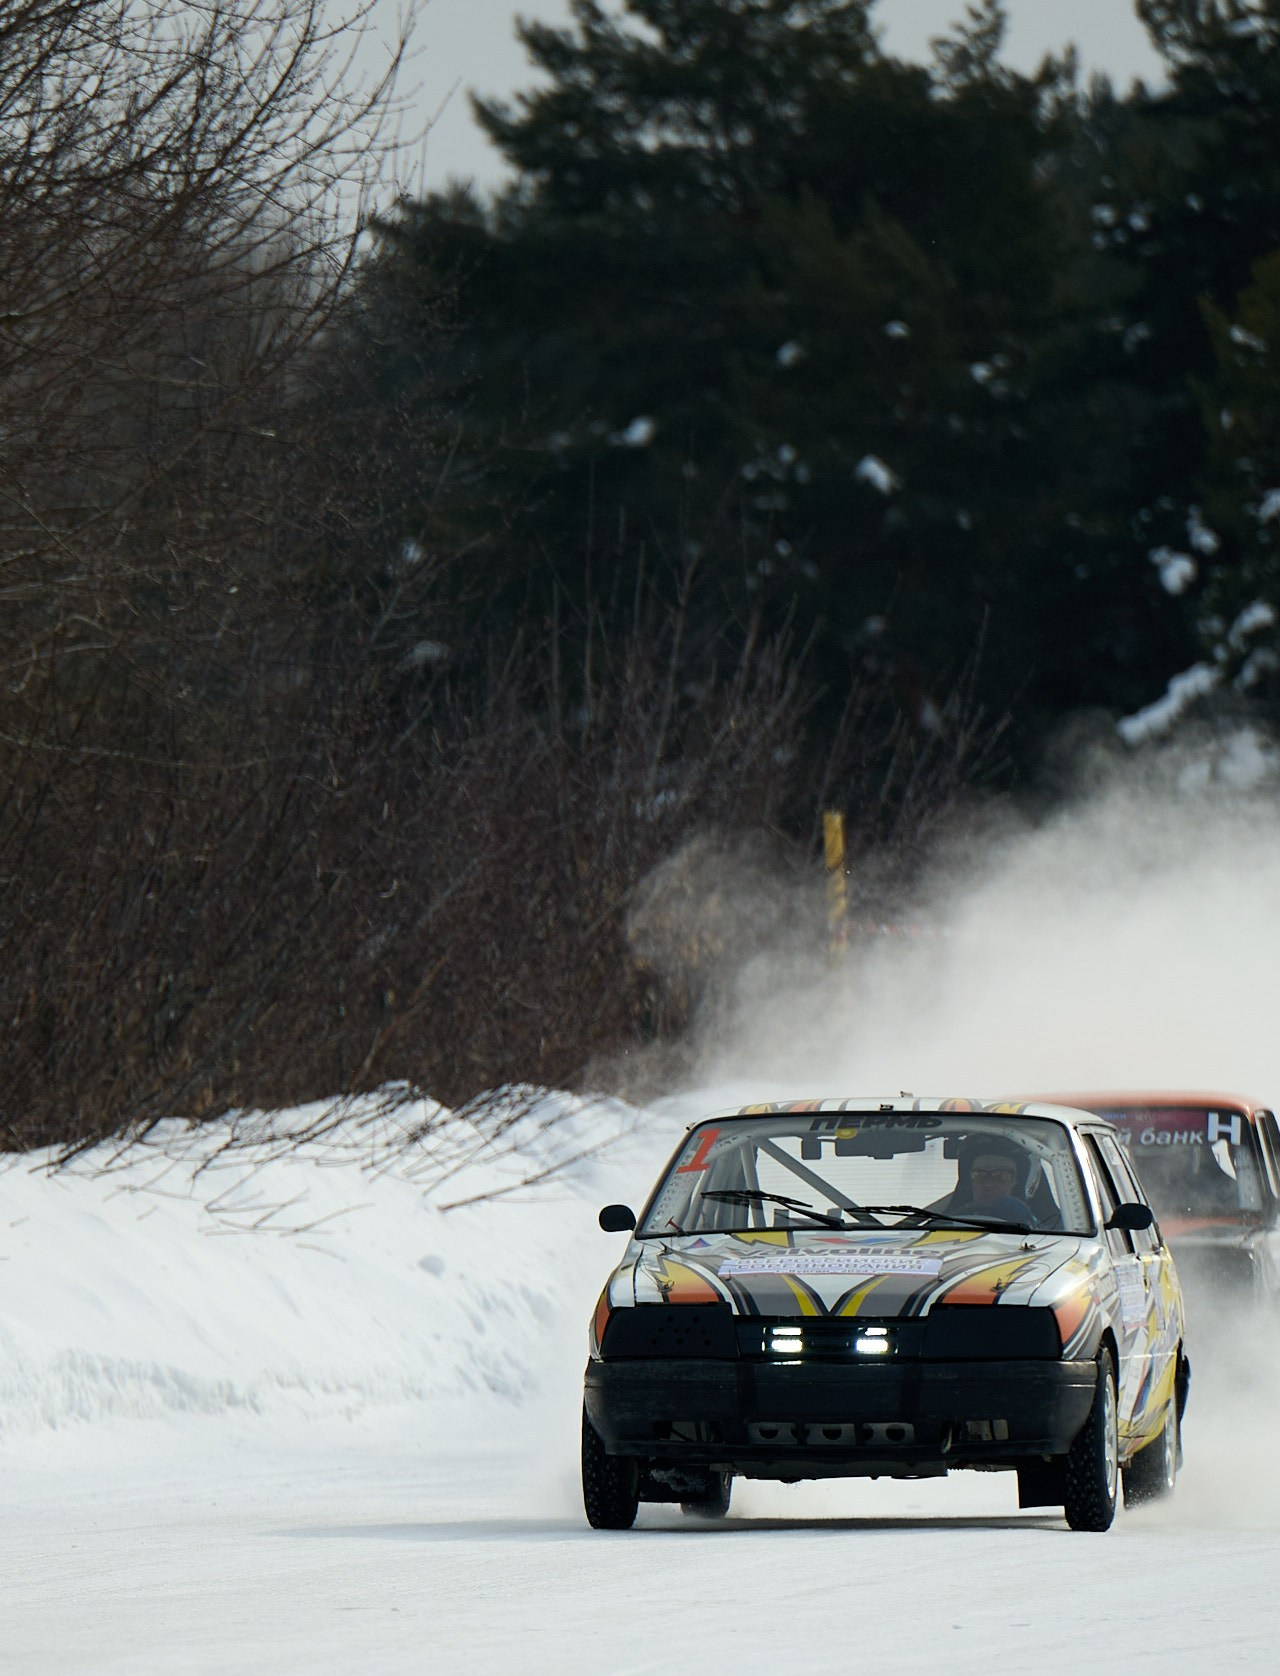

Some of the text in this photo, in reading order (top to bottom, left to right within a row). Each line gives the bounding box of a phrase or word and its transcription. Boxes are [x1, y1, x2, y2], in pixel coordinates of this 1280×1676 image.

[809, 1115, 943, 1131] ПЕРМЬ
[1207, 1111, 1242, 1146] Н
[1140, 1126, 1204, 1146] банк
[676, 1128, 722, 1174] 1
[736, 1262, 924, 1270] СОРЕВНОВАНИЯ
[737, 1257, 924, 1266] ВСЕРОССИЙСКИЕ
